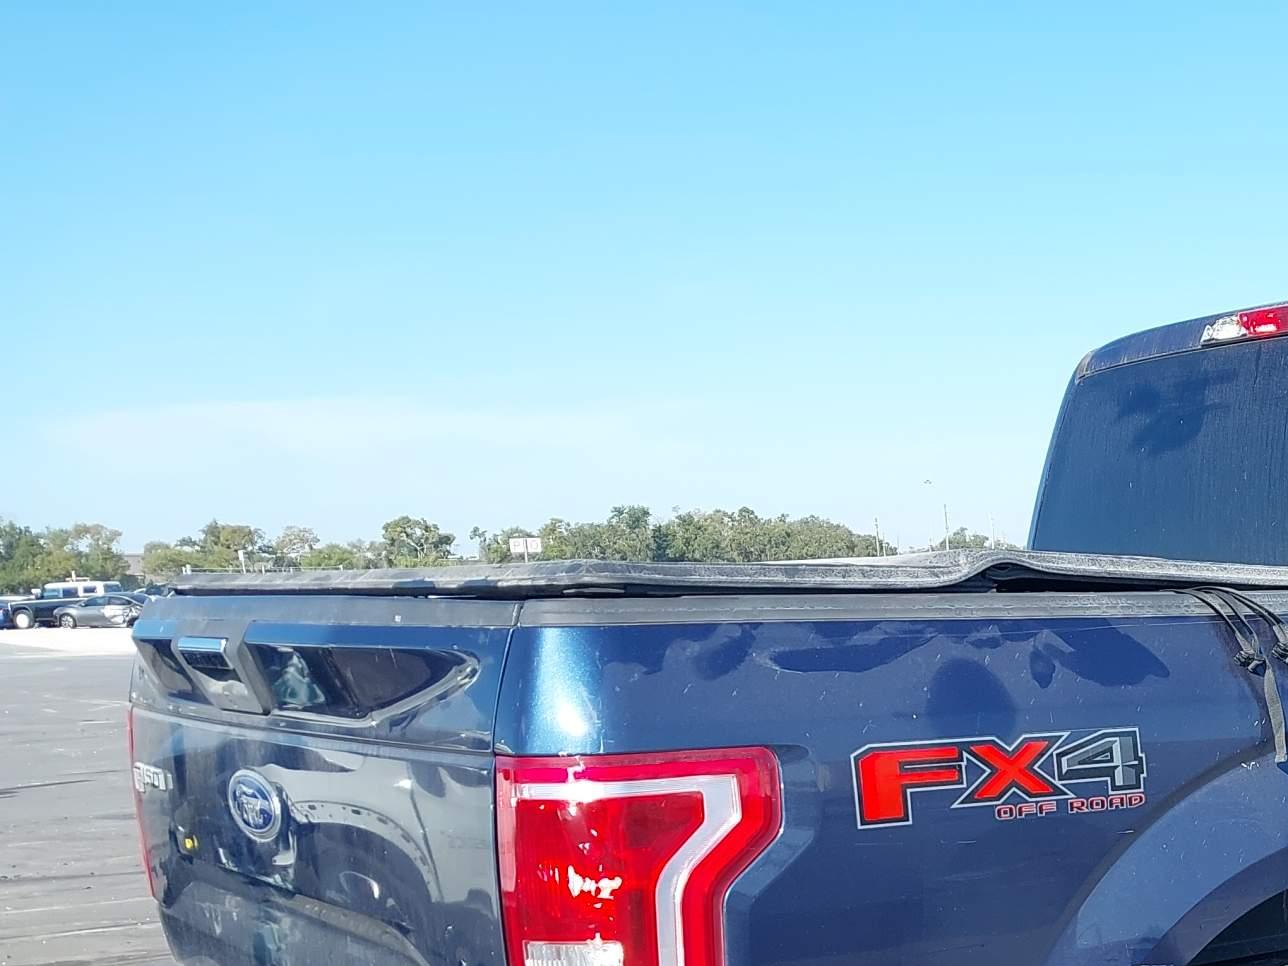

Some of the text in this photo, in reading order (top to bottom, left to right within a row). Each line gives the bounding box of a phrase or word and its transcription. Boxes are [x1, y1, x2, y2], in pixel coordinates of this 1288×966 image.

[850, 727, 1147, 829] FX4
[995, 793, 1146, 821] OFF ROAD
